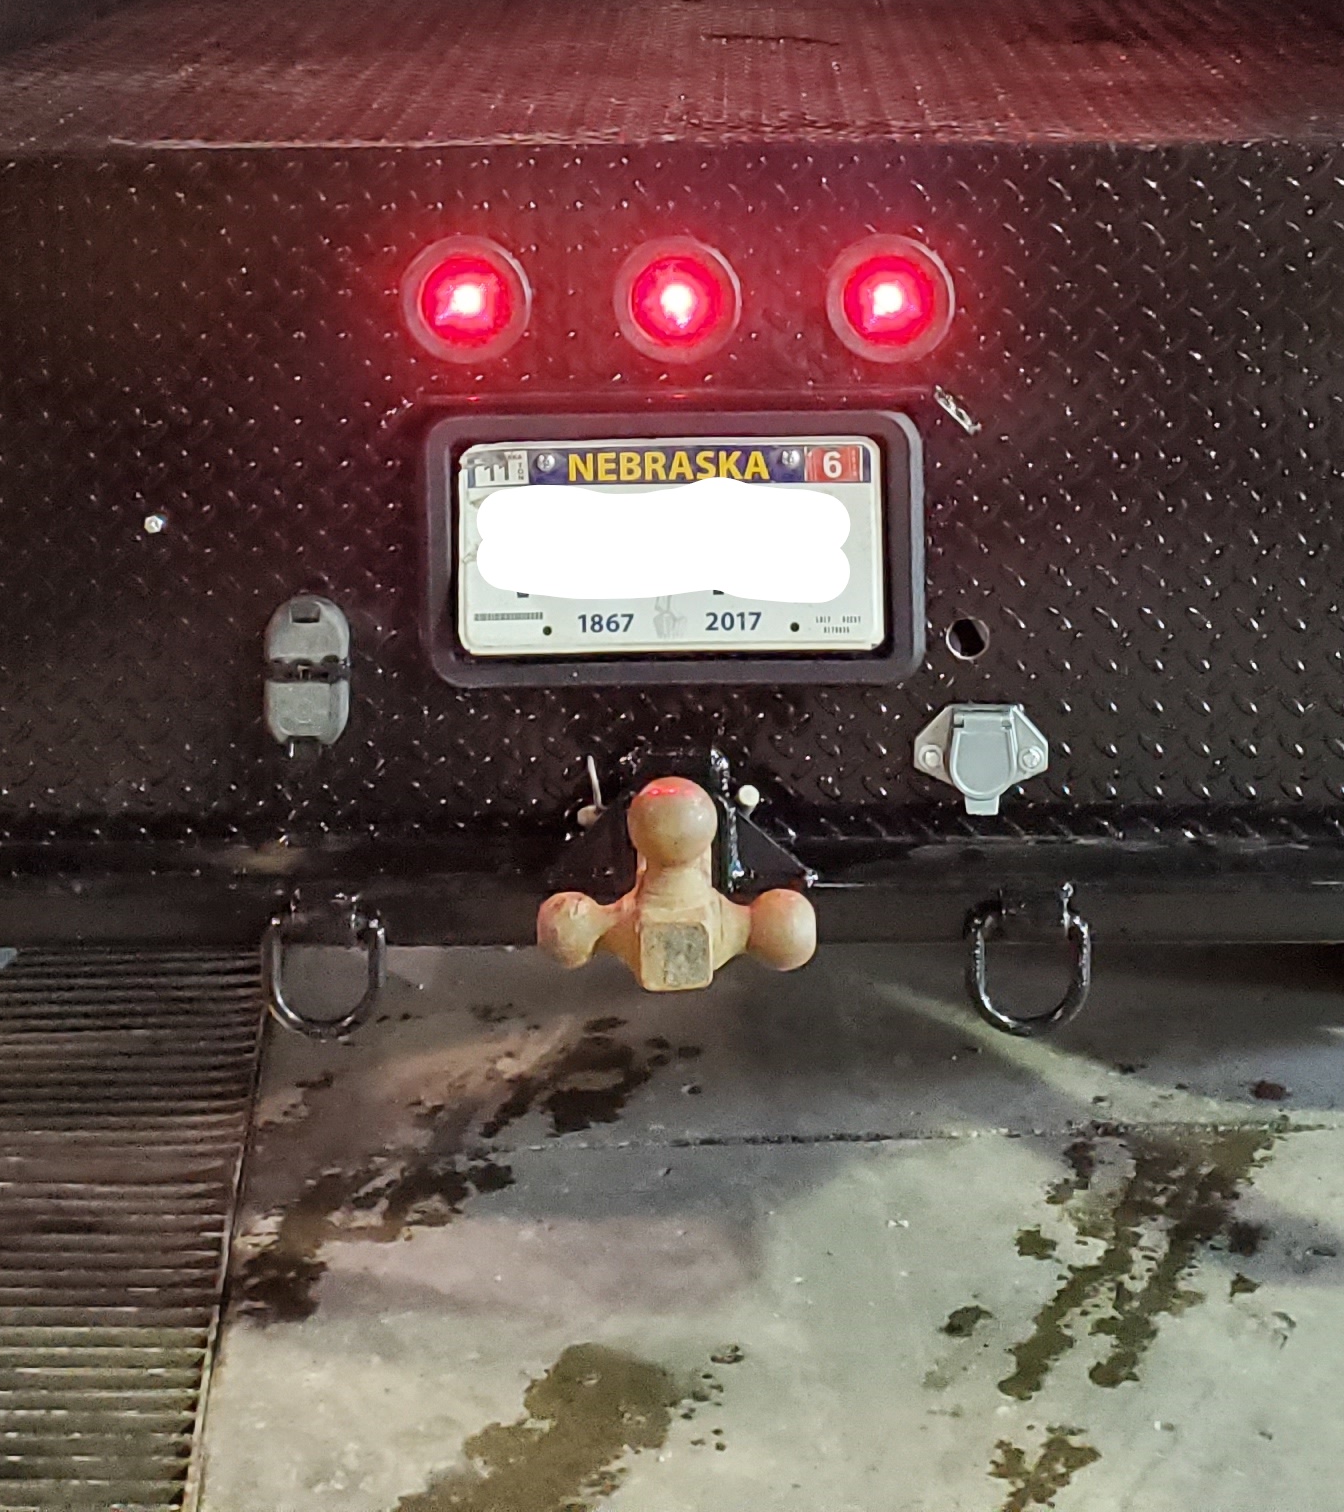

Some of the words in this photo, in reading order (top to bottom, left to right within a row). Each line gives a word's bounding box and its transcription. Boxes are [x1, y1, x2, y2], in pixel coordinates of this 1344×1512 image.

[568, 450, 770, 481] NEBRASKA
[823, 451, 842, 479] 6
[577, 613, 634, 634] 1867
[705, 612, 762, 631] 2017
